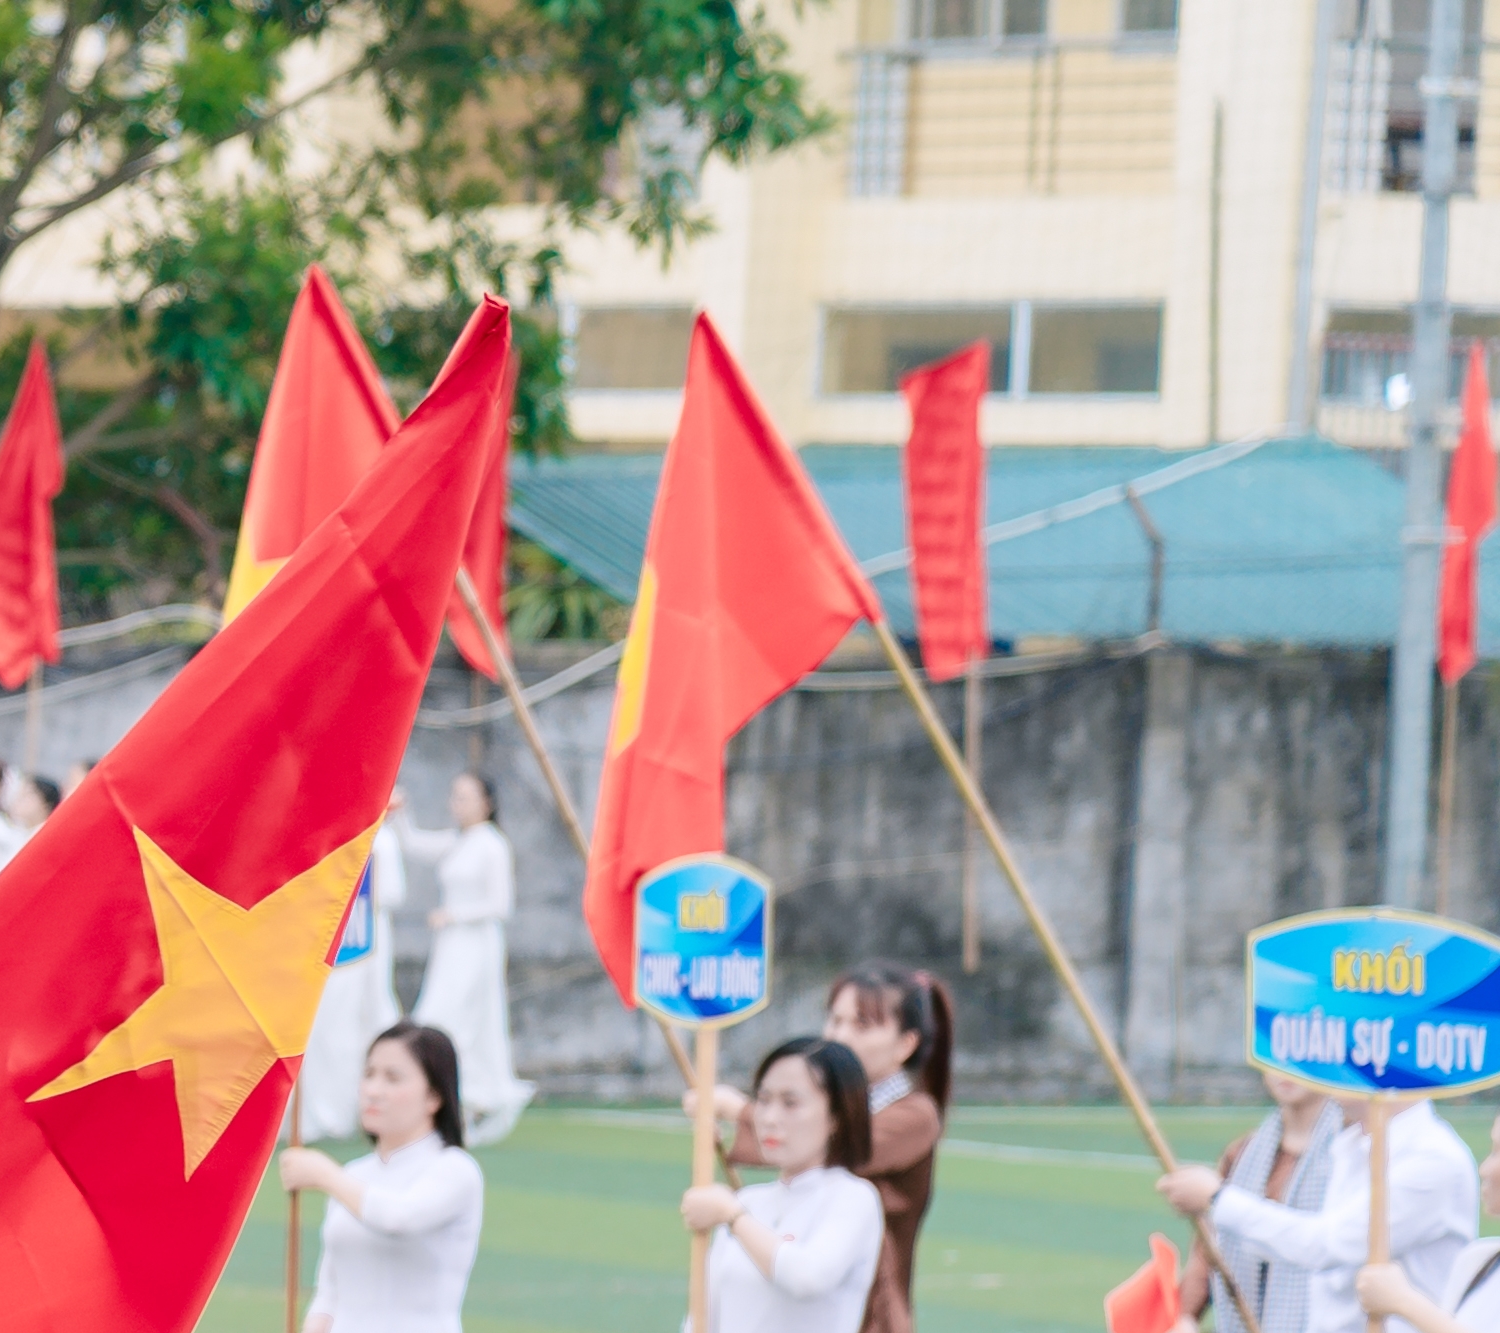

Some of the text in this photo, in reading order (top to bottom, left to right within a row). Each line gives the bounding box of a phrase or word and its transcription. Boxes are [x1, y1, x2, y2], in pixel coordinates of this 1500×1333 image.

[1333, 940, 1424, 995] KHỐI
[1270, 1007, 1346, 1064] QUÂN
[1352, 1017, 1393, 1077] SỰ
[1416, 1021, 1487, 1075] DQTV
